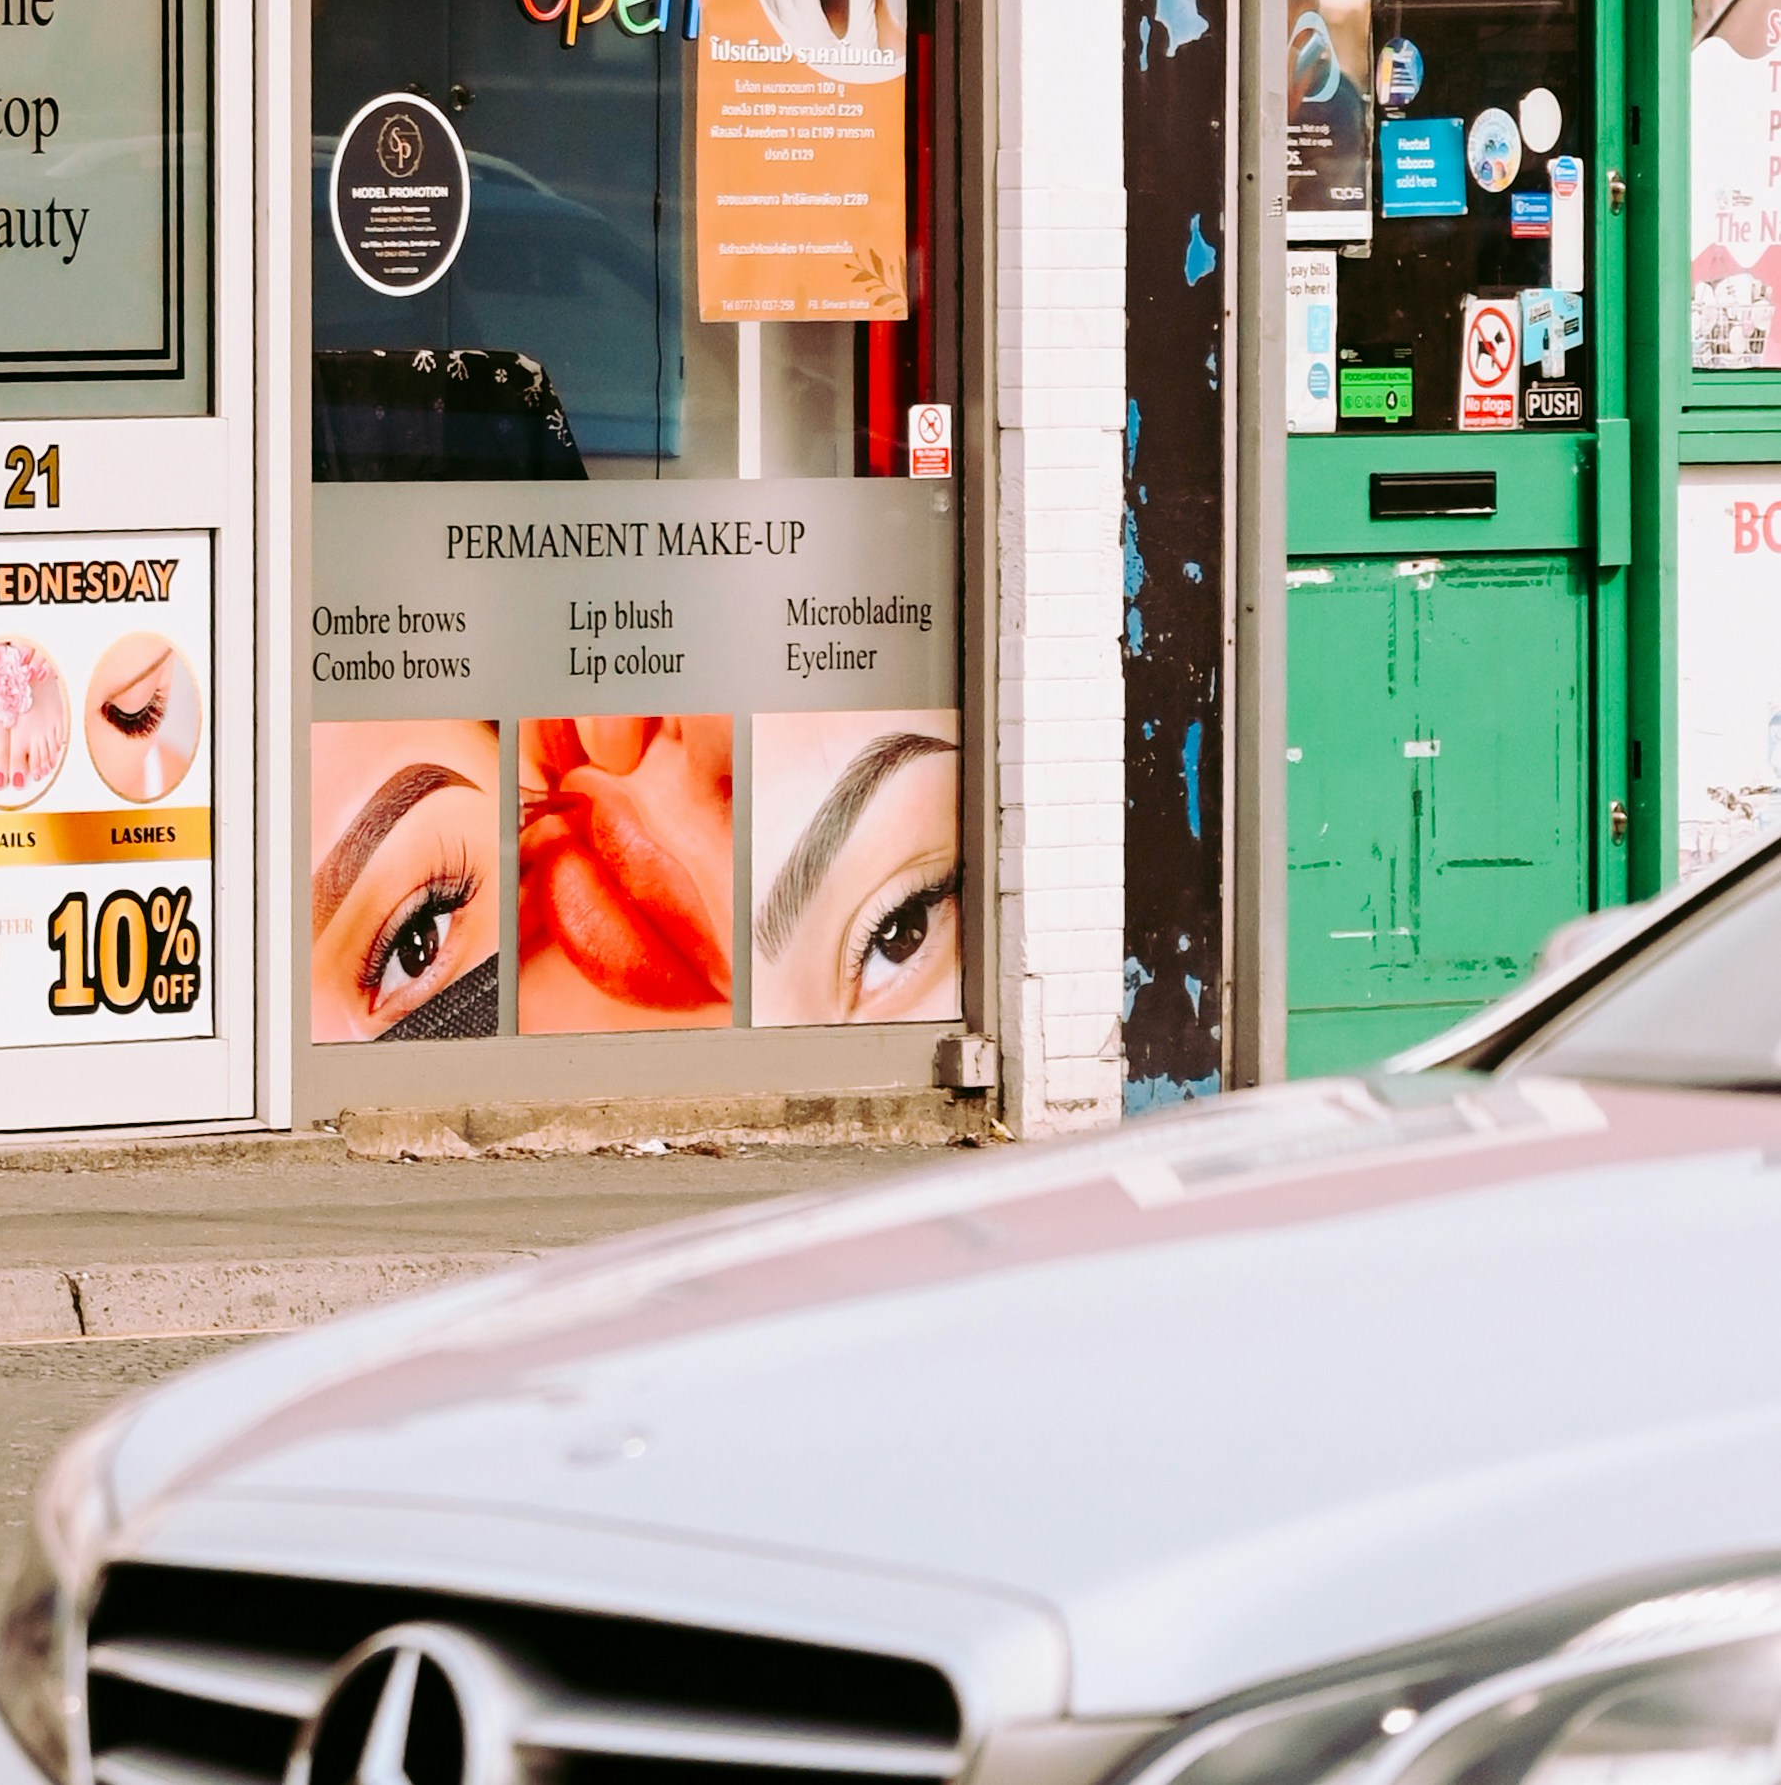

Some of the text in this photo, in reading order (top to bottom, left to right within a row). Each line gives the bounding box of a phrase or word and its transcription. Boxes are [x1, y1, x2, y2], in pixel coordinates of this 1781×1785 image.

[1397, 137, 1431, 150] Heated
[1396, 156, 1435, 169] tobacco
[351, 186, 449, 199] MODEL PROMOTION
[1330, 187, 1365, 200] IQOS
[1396, 175, 1438, 189] sold here
[1716, 212, 1751, 242] The
[1291, 263, 1331, 279] pay bills
[1304, 282, 1331, 295] here!
[1465, 396, 1512, 415] No dogs
[1529, 393, 1579, 417] PUSH
[3, 443, 61, 509] 21
[445, 519, 807, 560] PERMANENT MAKE-UP
[312, 605, 467, 638] Ombre brows
[569, 599, 674, 635] Lip blush
[785, 594, 934, 631] Microblading
[312, 650, 471, 684] Combo brows
[569, 646, 685, 683] Lip colour
[785, 644, 878, 680] Eyeliner
[110, 824, 177, 845] LASHES
[50, 890, 198, 1011] 10% OFF
